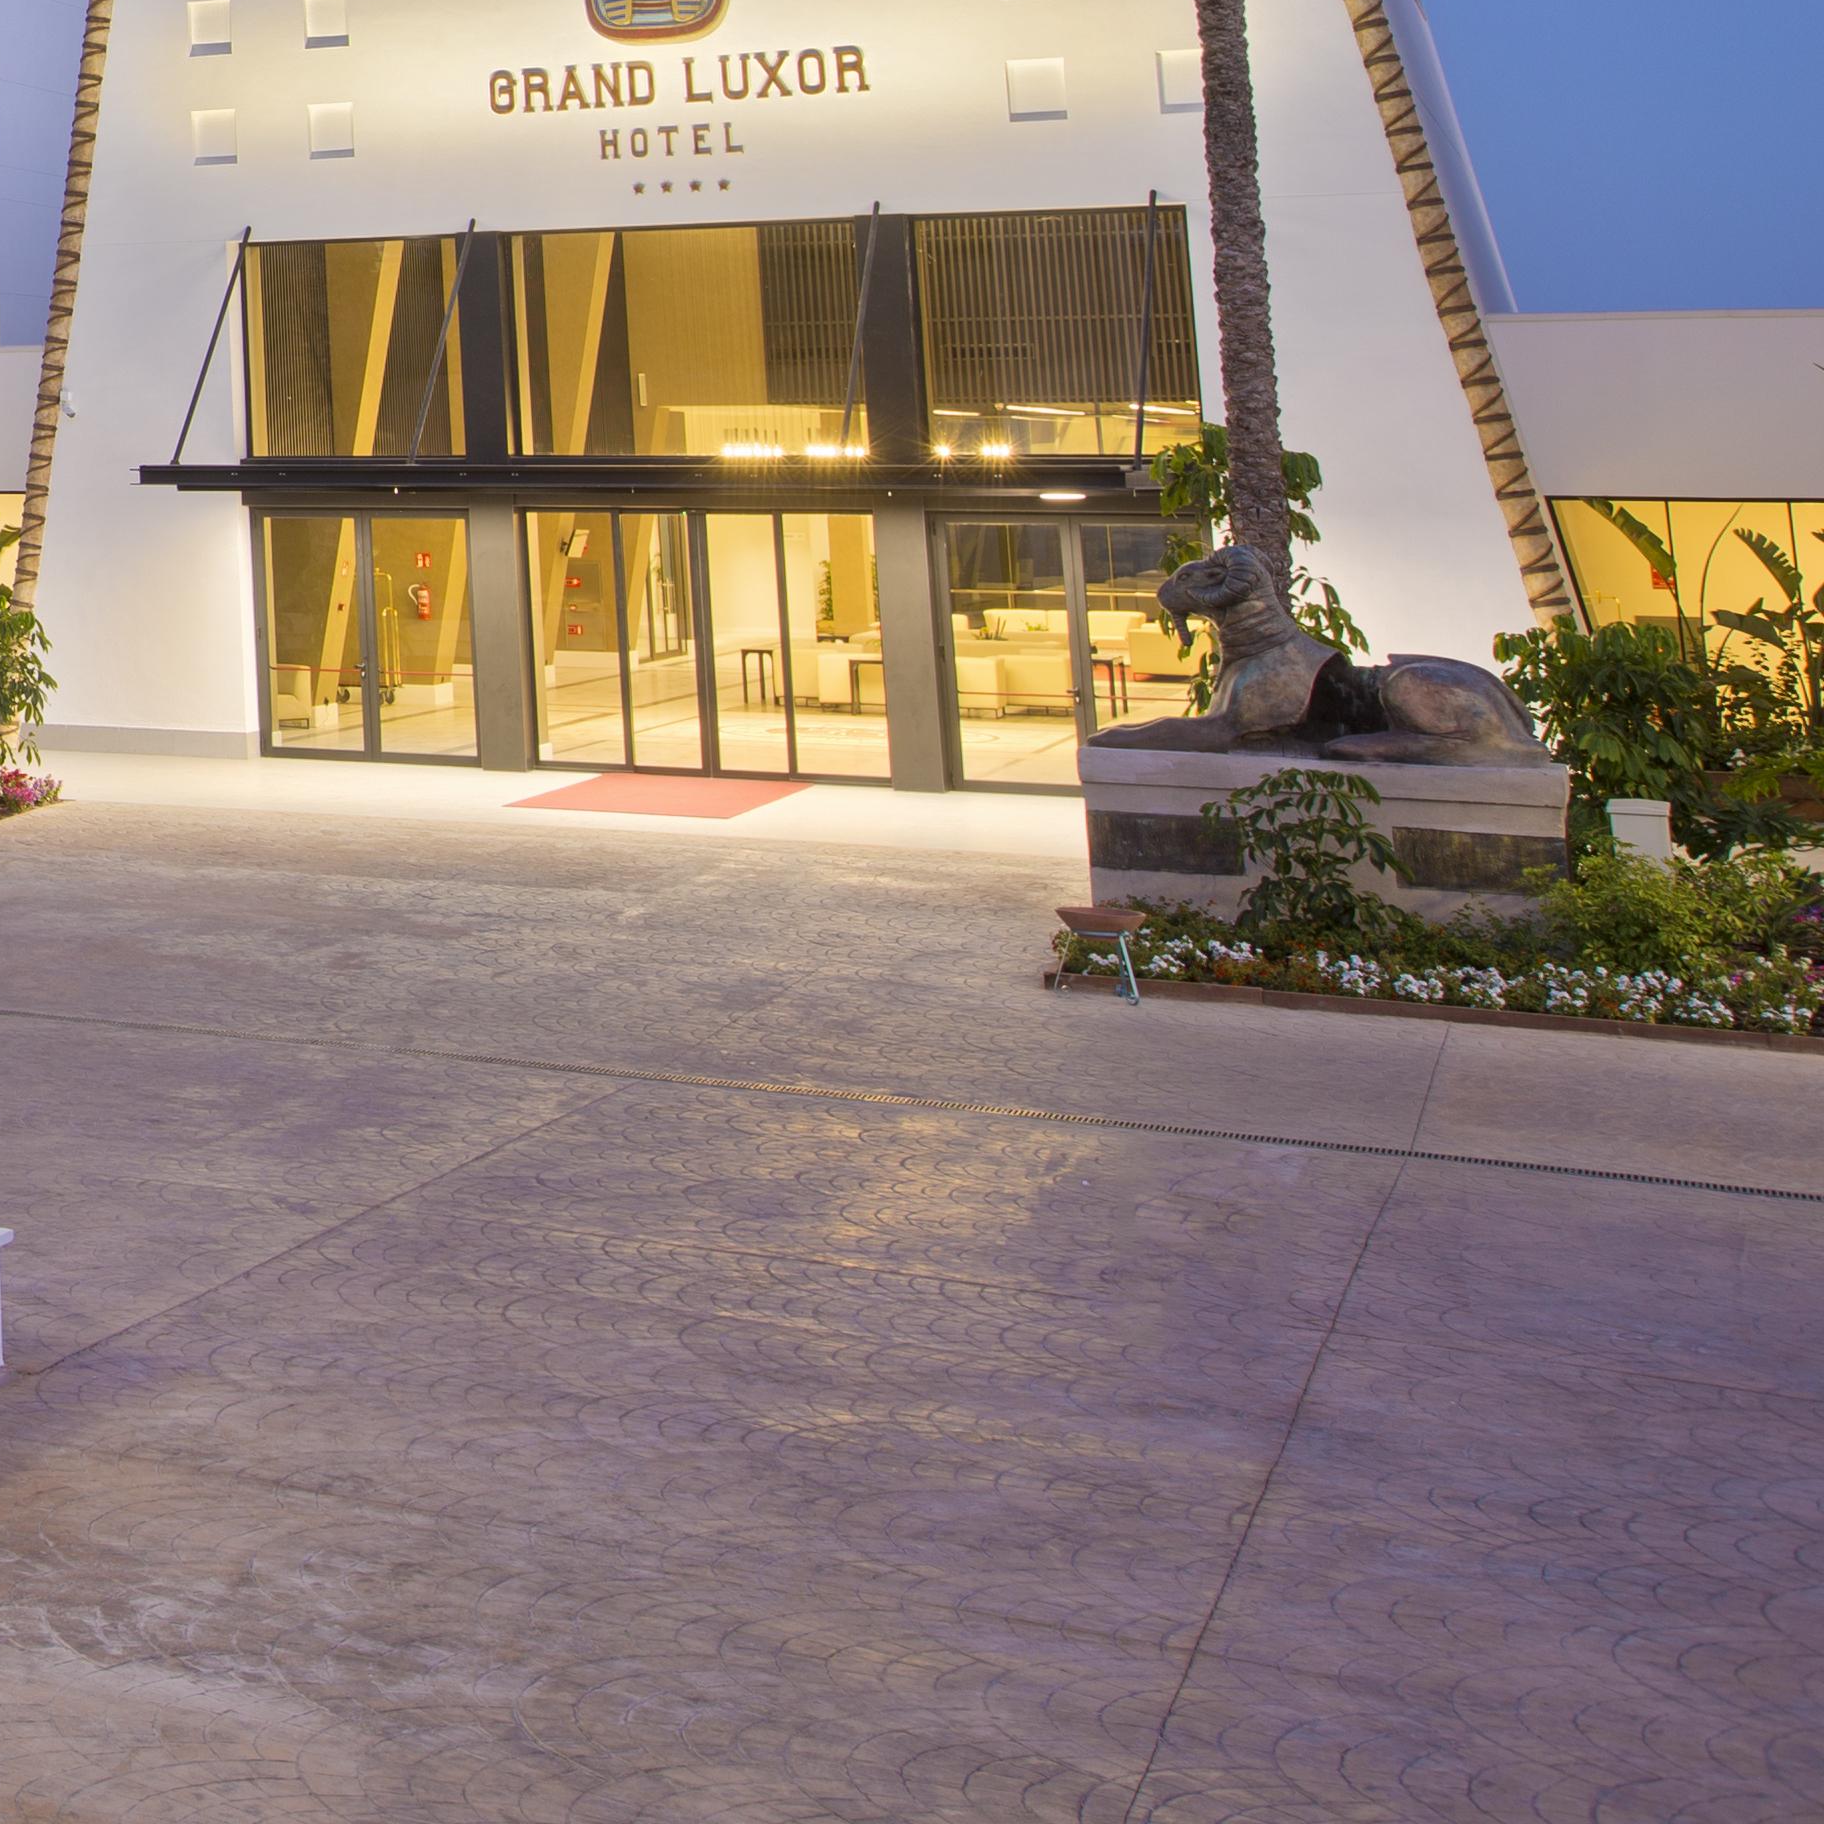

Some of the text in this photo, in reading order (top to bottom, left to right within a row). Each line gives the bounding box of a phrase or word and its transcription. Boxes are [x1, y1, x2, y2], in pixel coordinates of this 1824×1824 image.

[488, 45, 871, 115] GRAND LUXOR
[599, 122, 745, 160] HOTEL
